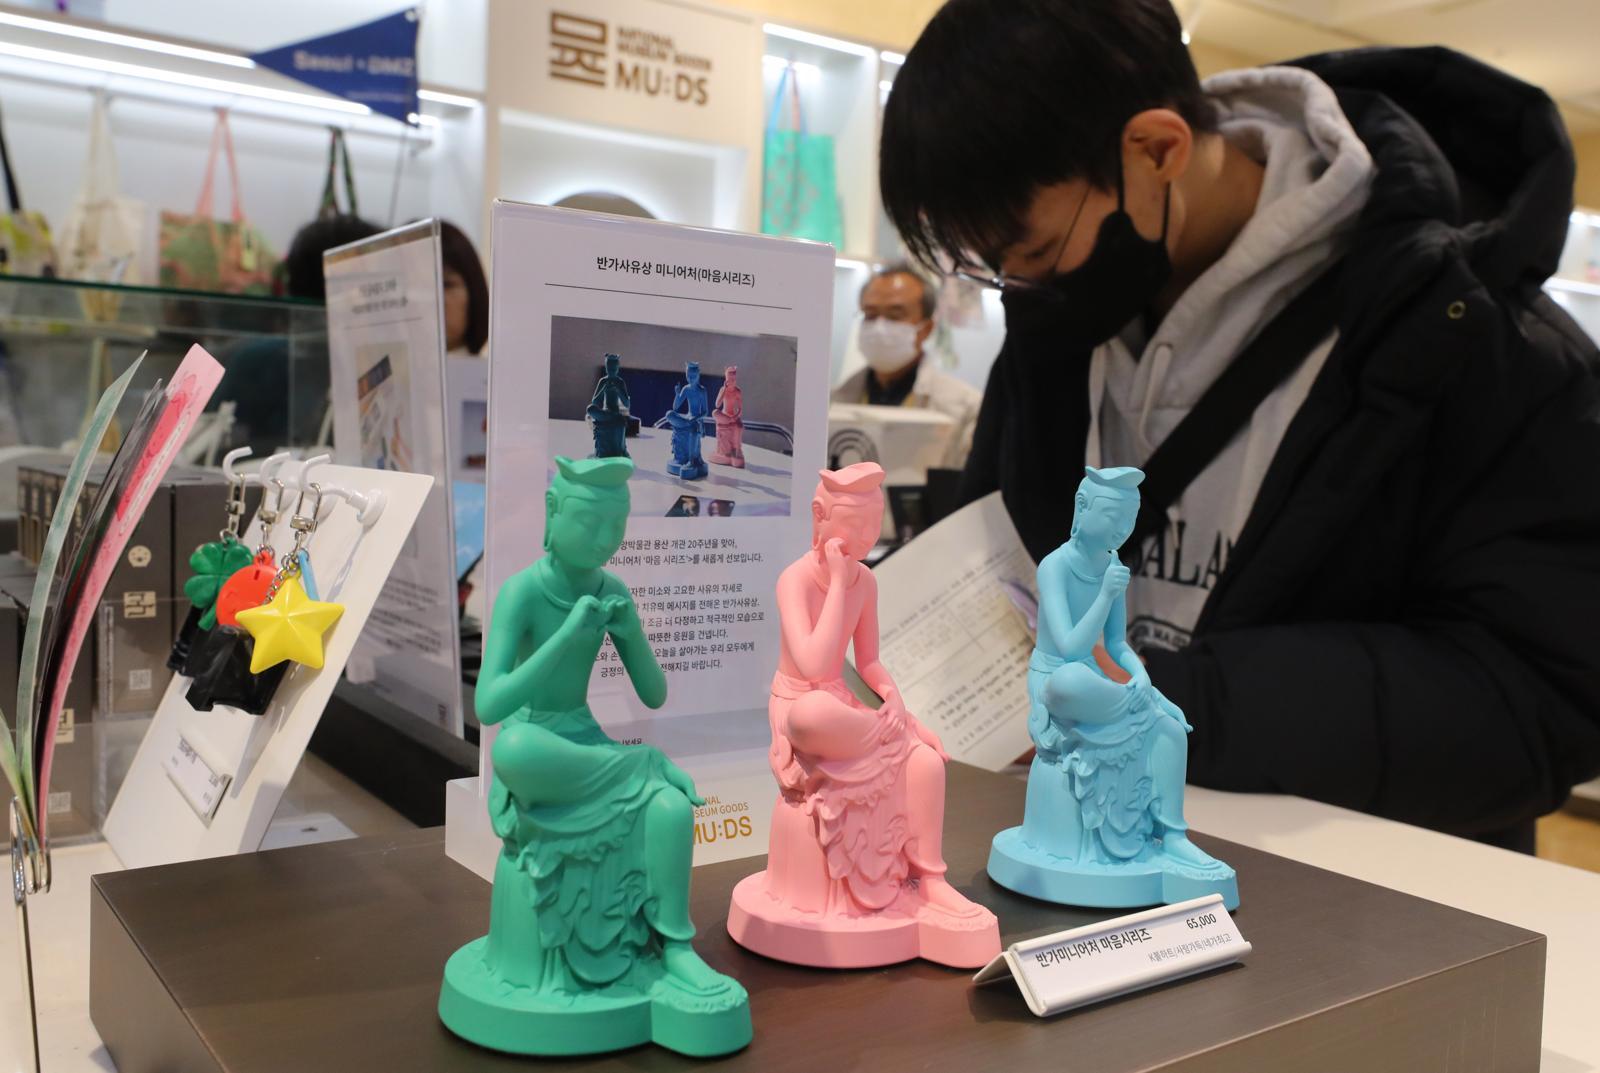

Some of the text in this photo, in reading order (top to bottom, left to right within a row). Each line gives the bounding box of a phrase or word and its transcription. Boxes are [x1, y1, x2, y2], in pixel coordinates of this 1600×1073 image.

[615, 61, 708, 106] MU:DS
[597, 256, 755, 288] 반가사유상 미니어처(마음시리즈)
[620, 539, 651, 550] 앙박물관
[653, 540, 669, 550] 용산
[671, 539, 686, 549] 개관
[688, 539, 718, 549] 20주년을
[702, 553, 724, 564] 새롭게
[726, 553, 764, 563] 선보입니다.
[628, 583, 743, 598] 자한 미소와 고요한 사유의 자세로
[642, 602, 665, 613] 치유의
[666, 600, 696, 611] 메시지를
[699, 599, 720, 610] 전해온
[647, 617, 663, 628] 조금
[665, 616, 673, 627] 더
[674, 614, 704, 626] 다정하고
[706, 613, 735, 624] 적극적인
[736, 611, 765, 622] 모습으로
[648, 629, 729, 643] 따뜻한 응원을 건넵니다.
[654, 647, 677, 658] 오늘을
[679, 645, 707, 656] 살아가는
[710, 643, 725, 654] 우리
[726, 641, 755, 652] 모두에게
[600, 659, 723, 678] 긍정의 전해지길 바랍니다.
[719, 801, 749, 815] GOODS
[1035, 913, 1217, 968] 반가미니어처 마음시리즈 65,000
